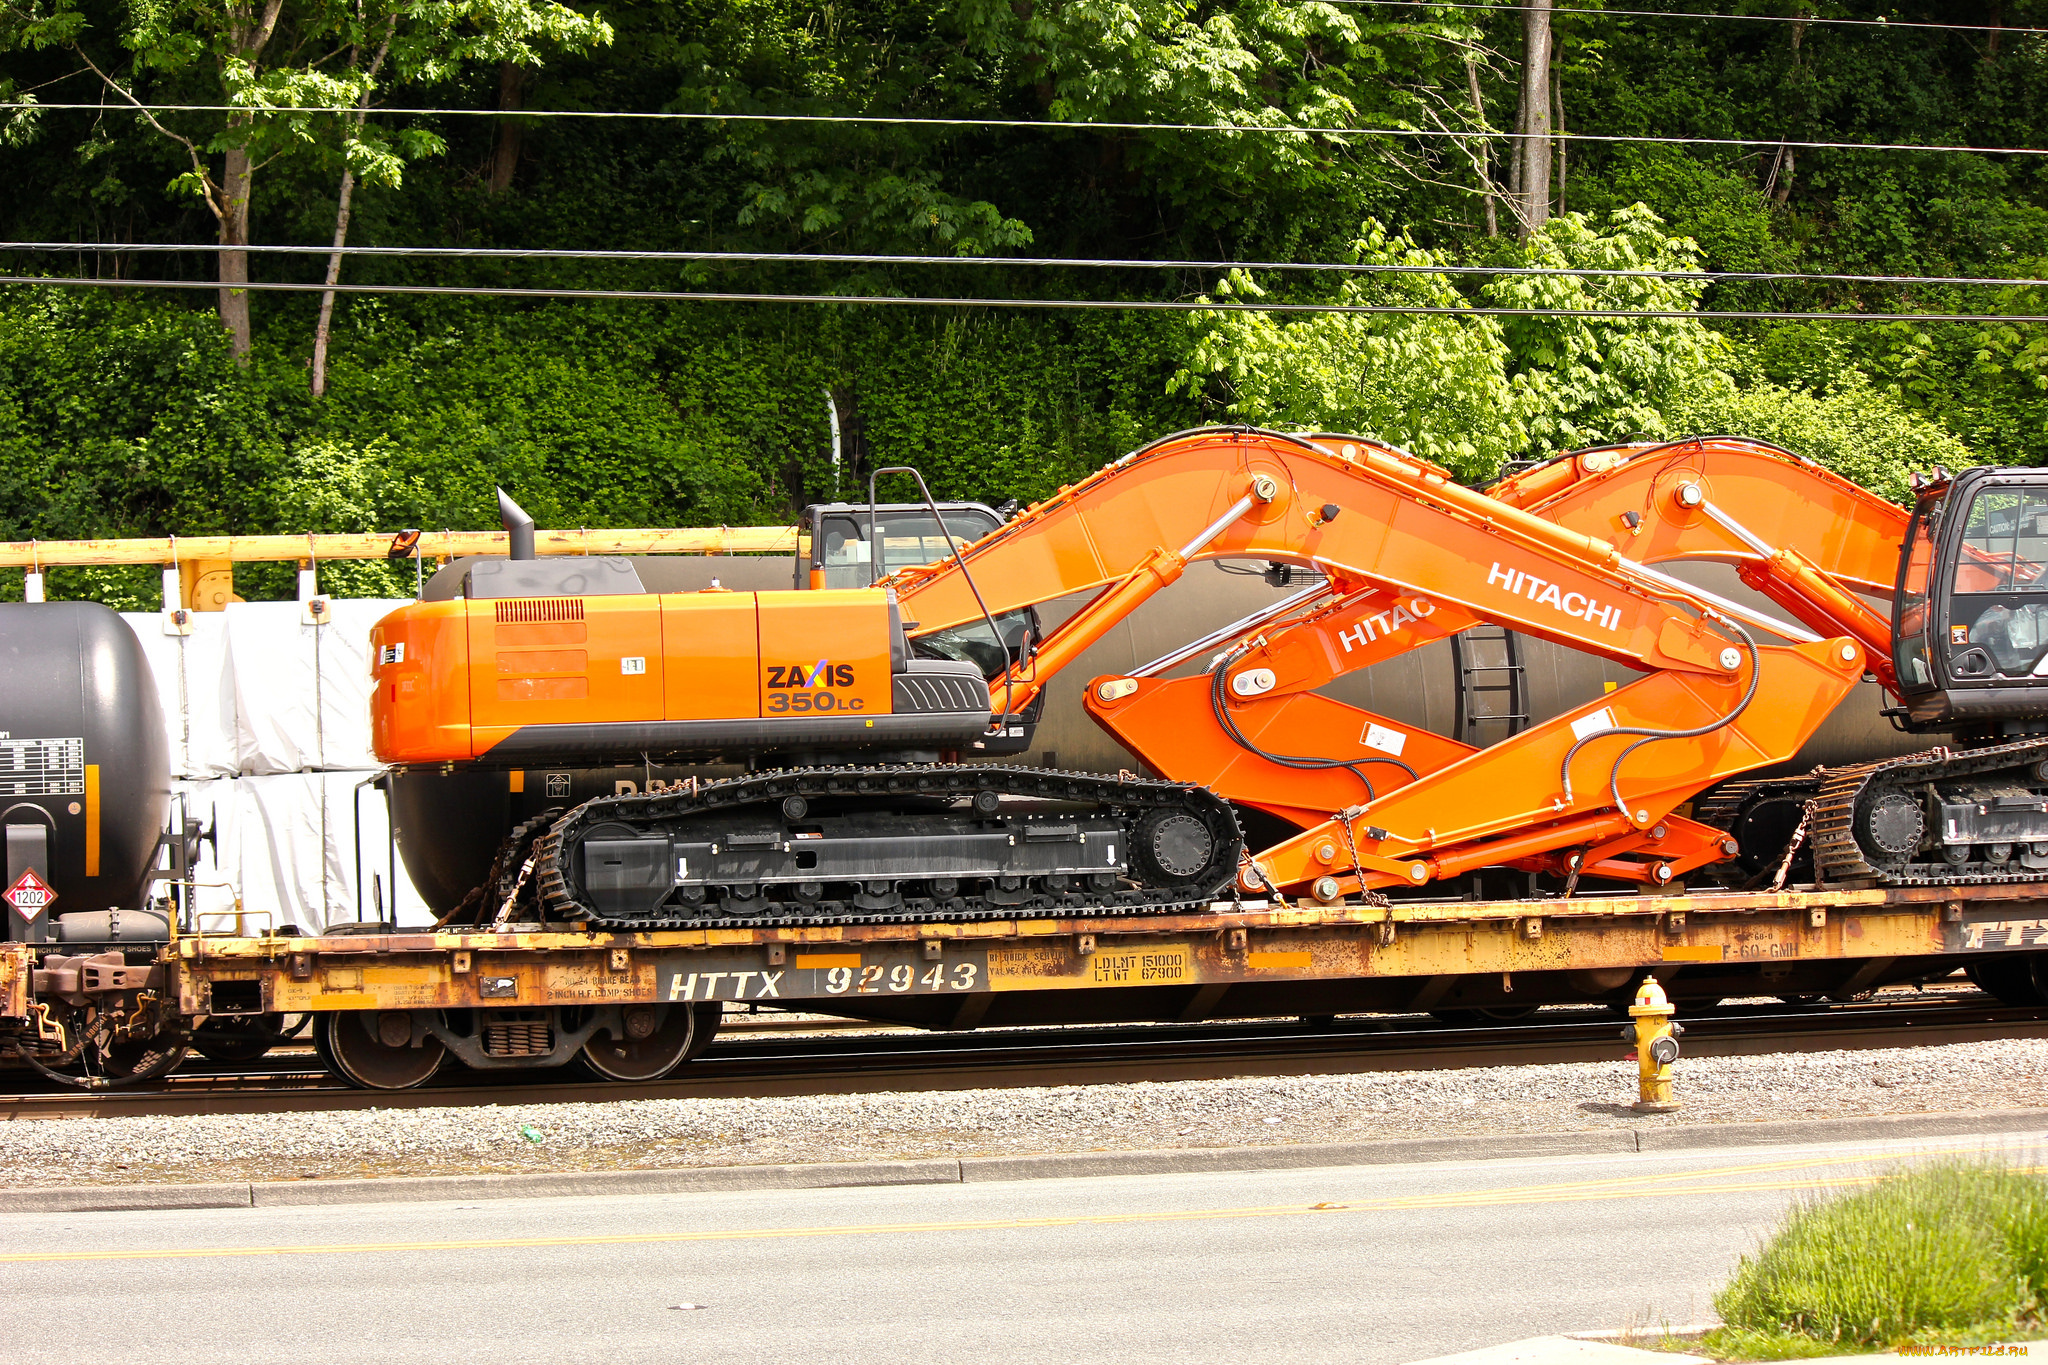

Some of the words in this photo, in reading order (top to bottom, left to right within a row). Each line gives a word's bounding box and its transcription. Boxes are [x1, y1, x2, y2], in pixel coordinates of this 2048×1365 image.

[1487, 562, 1621, 631] HITACHI
[1338, 597, 1436, 653] HITAC
[767, 660, 855, 688] ZAXIS
[16, 891, 44, 904] 1202
[1142, 954, 1182, 967] 151000
[669, 970, 785, 1001] HTTX
[825, 962, 978, 994] 92943
[1142, 967, 1182, 980] 67900
[547, 992, 553, 1000] 2
[555, 990, 576, 999] INCH
[623, 987, 652, 997] SHOES
